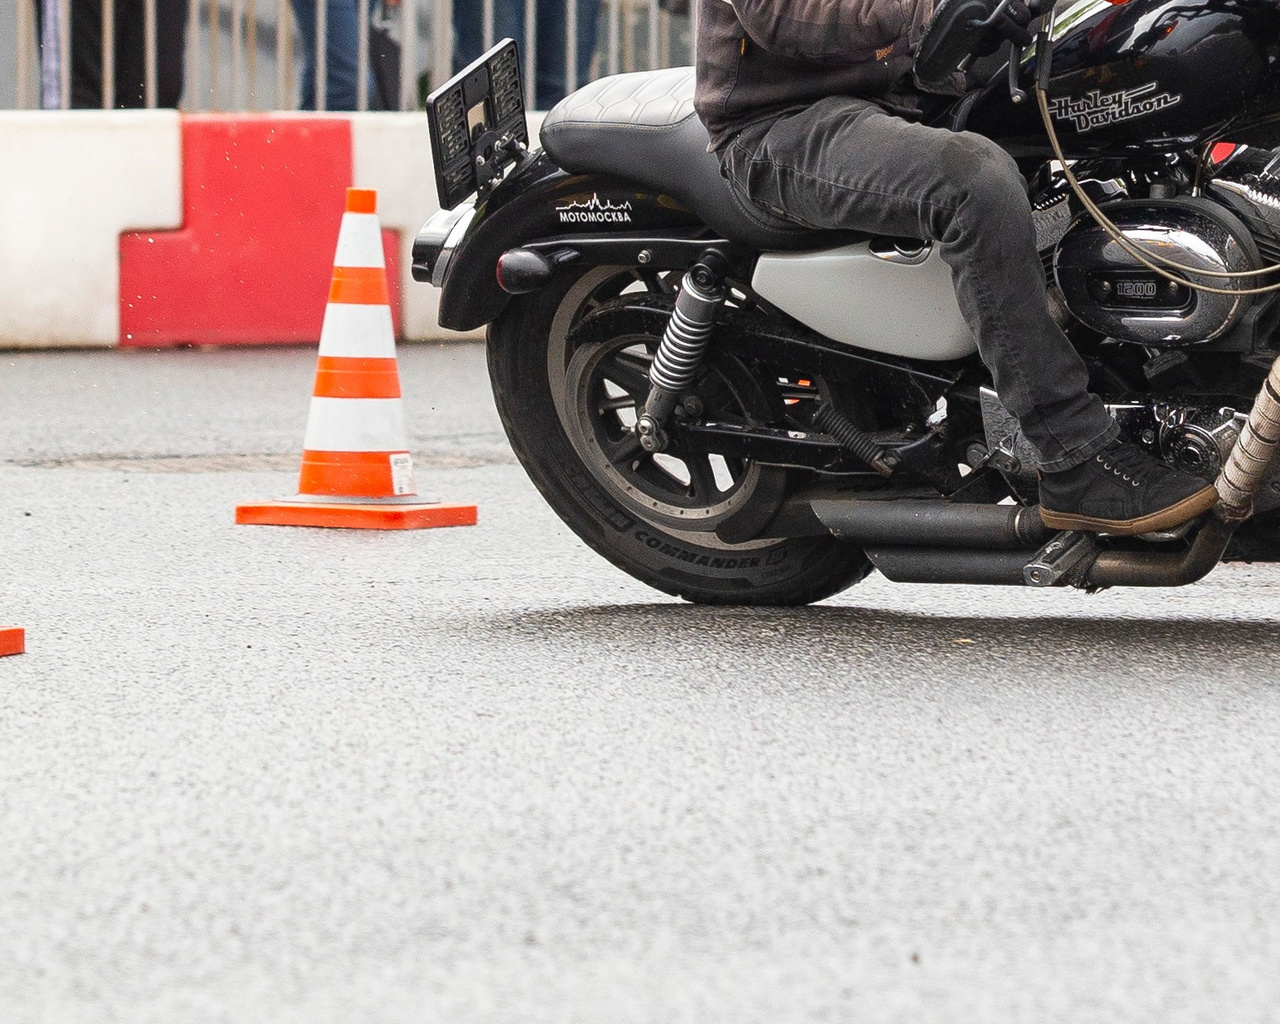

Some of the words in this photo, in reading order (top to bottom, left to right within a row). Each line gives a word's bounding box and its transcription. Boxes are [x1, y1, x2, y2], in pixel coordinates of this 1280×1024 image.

[1048, 81, 1157, 120] Harley
[1070, 93, 1181, 132] Davidson
[559, 211, 631, 223] МОТОМОСКВА
[1117, 282, 1156, 296] 1200
[634, 530, 762, 569] COMMANDER
